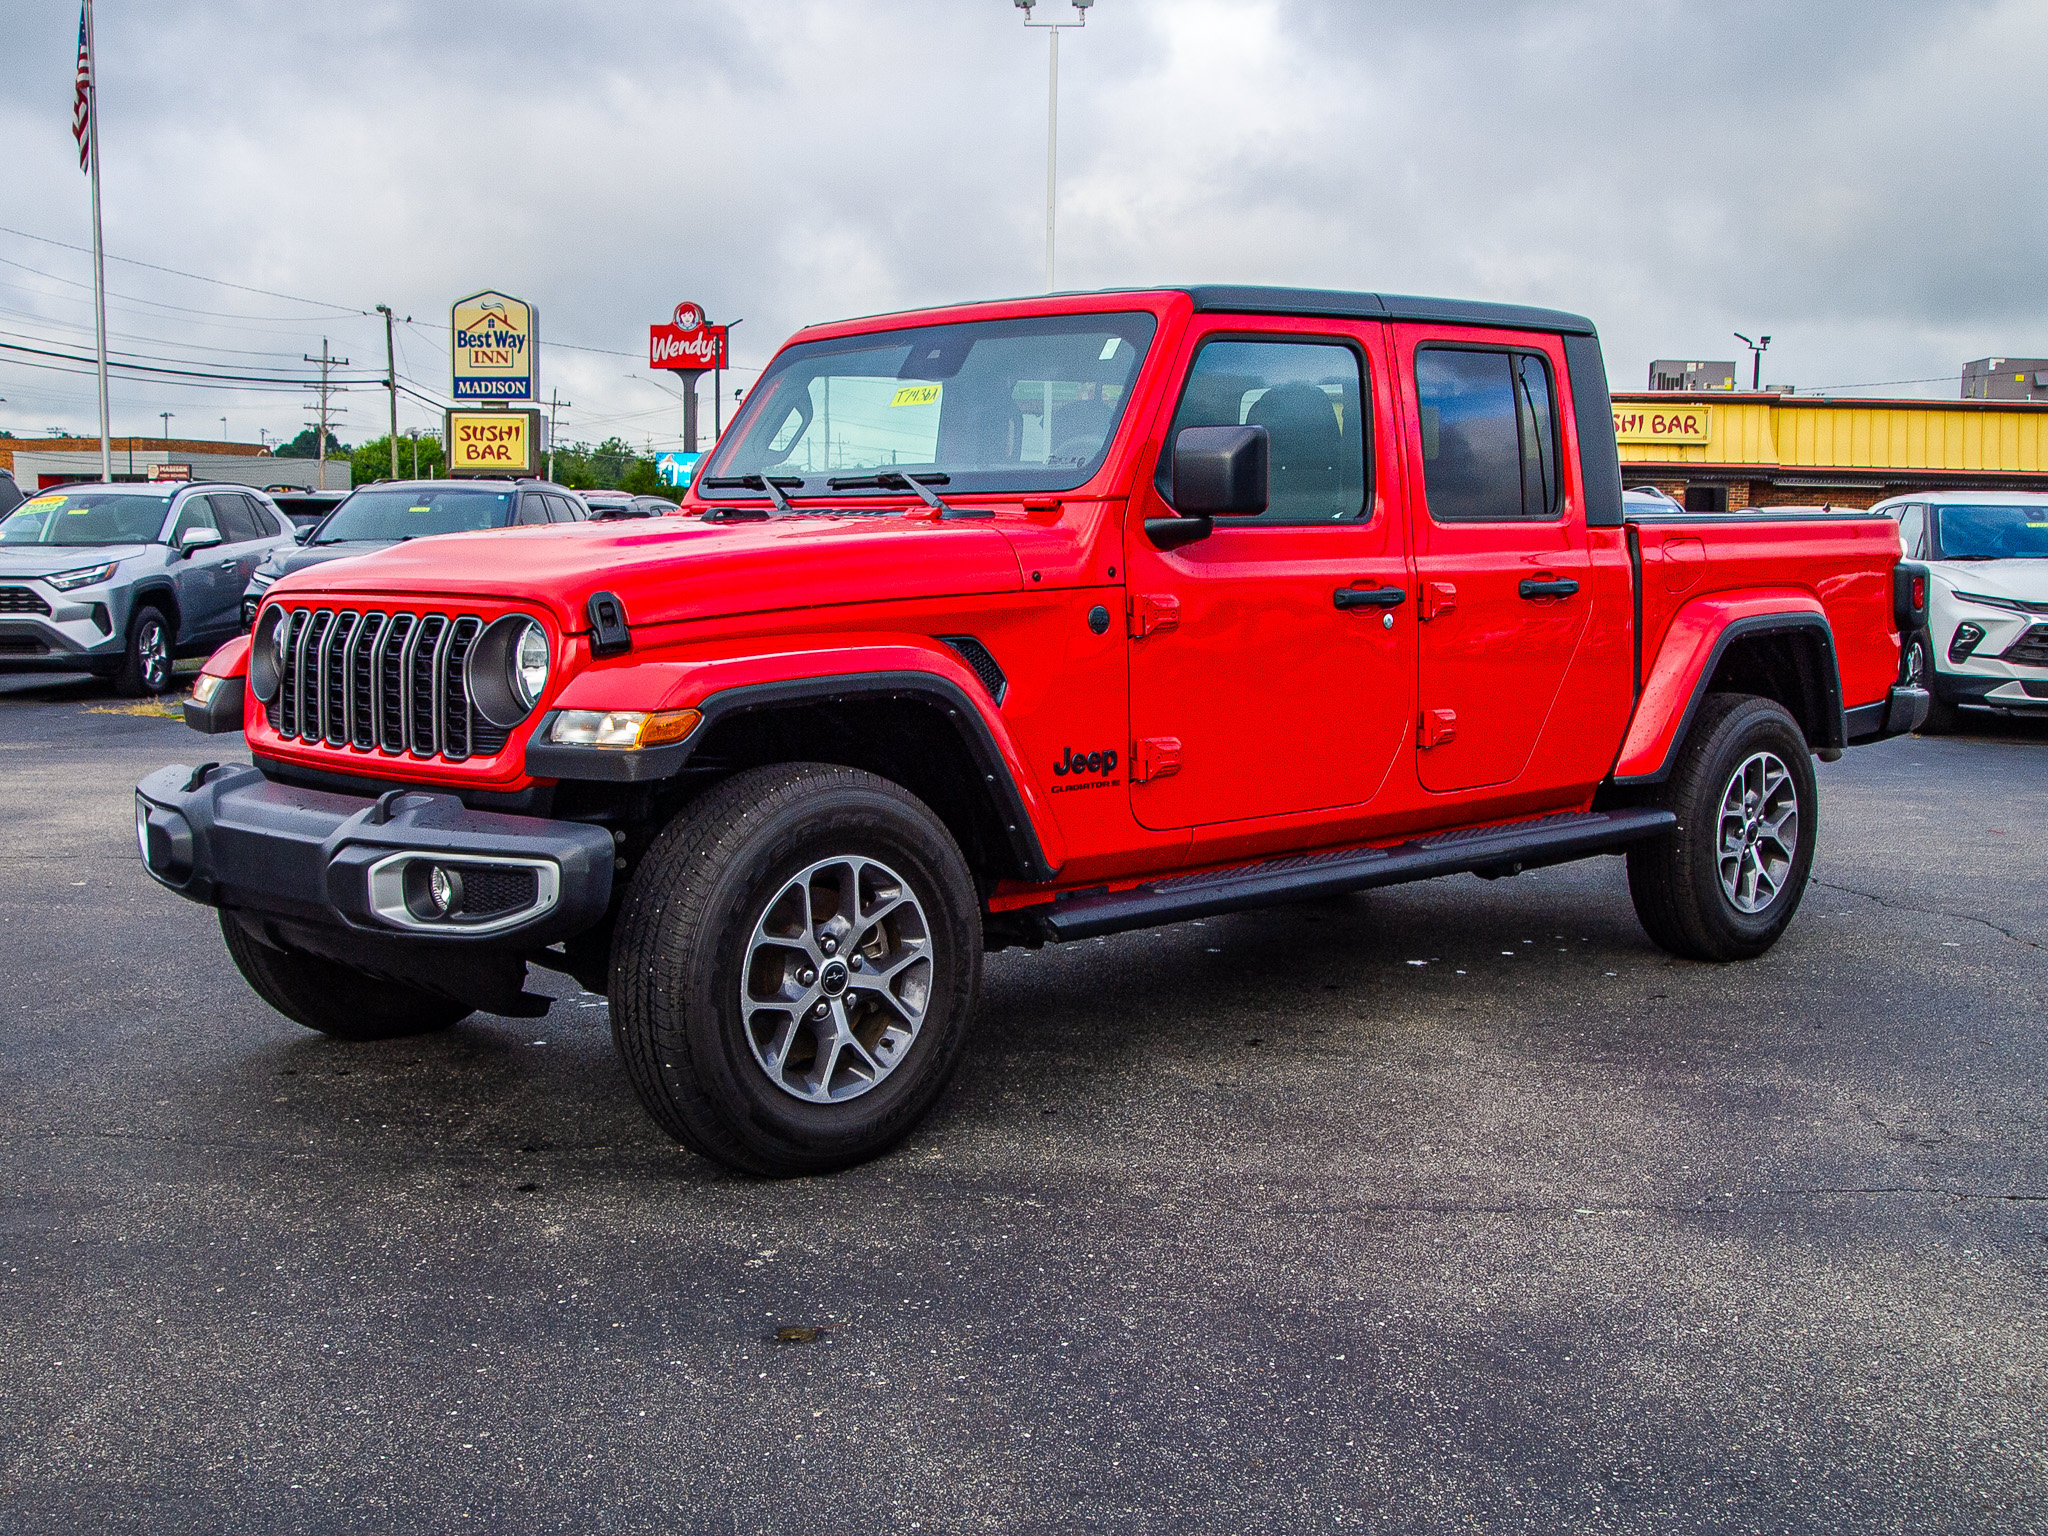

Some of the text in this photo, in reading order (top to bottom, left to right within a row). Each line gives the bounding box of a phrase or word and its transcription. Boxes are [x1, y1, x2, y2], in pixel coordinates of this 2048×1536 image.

[457, 330, 525, 354] Best Way
[473, 350, 509, 363] INN
[457, 381, 526, 394] MADISON
[1652, 414, 1699, 434] BAR
[459, 425, 520, 441] SUSHI
[466, 444, 512, 460] BAR
[1053, 746, 1117, 776] Jeep
[1051, 780, 1110, 793] GLADIATOR
